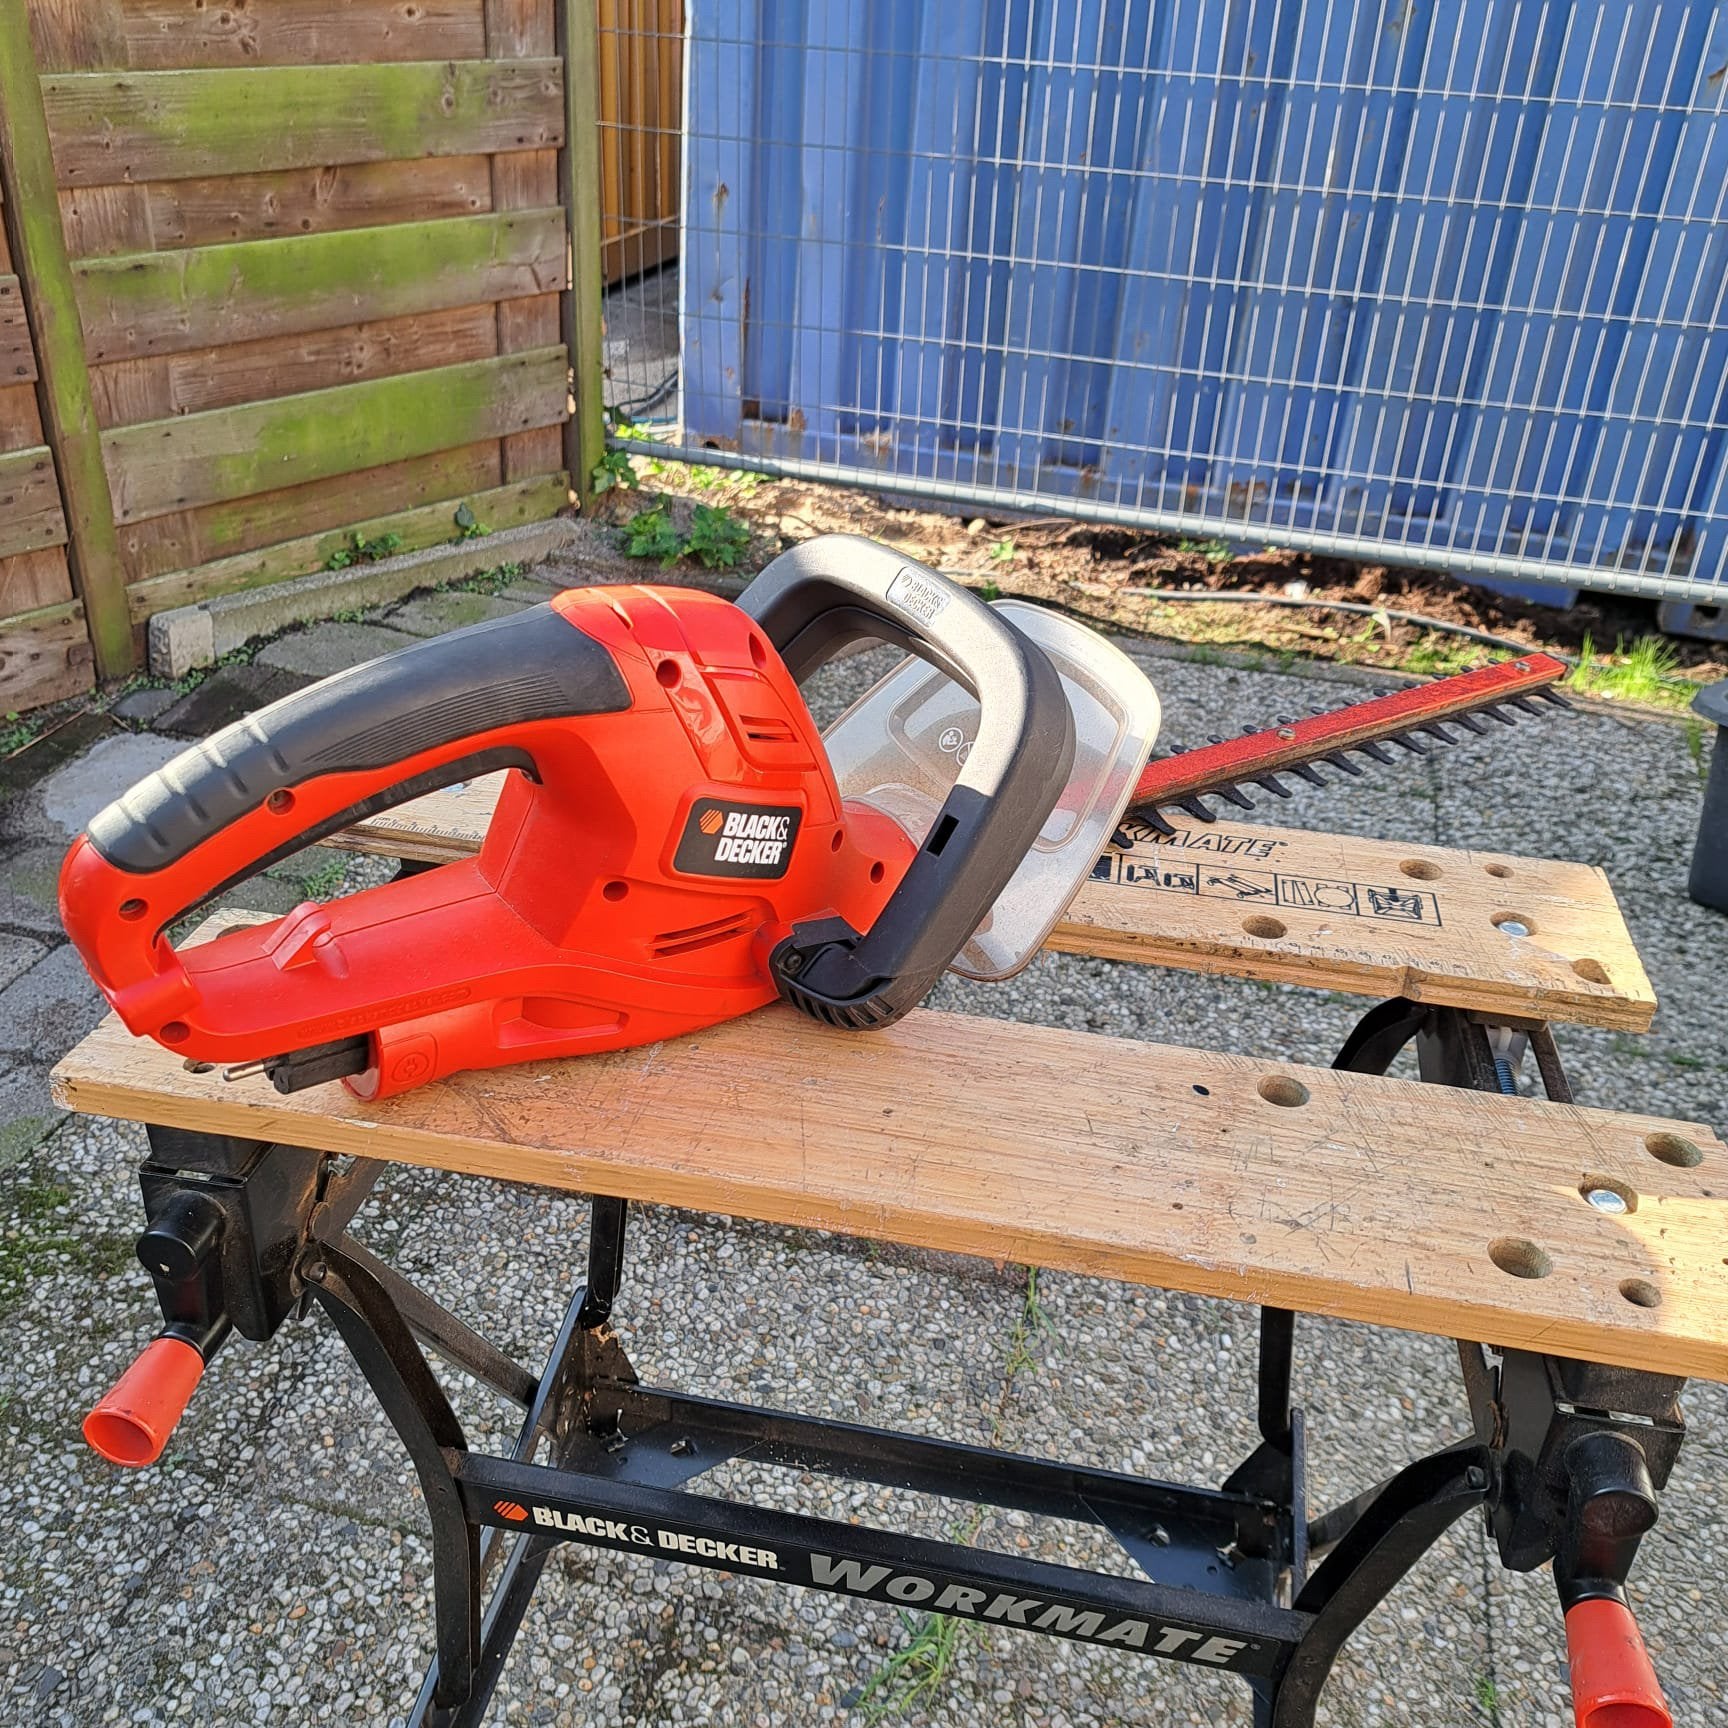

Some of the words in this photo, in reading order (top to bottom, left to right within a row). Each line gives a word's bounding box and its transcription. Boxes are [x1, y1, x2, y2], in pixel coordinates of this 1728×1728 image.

[714, 837, 783, 865] DECKER
[657, 1530, 780, 1570] DECKER
[808, 1552, 1250, 1664] WORKMATE
